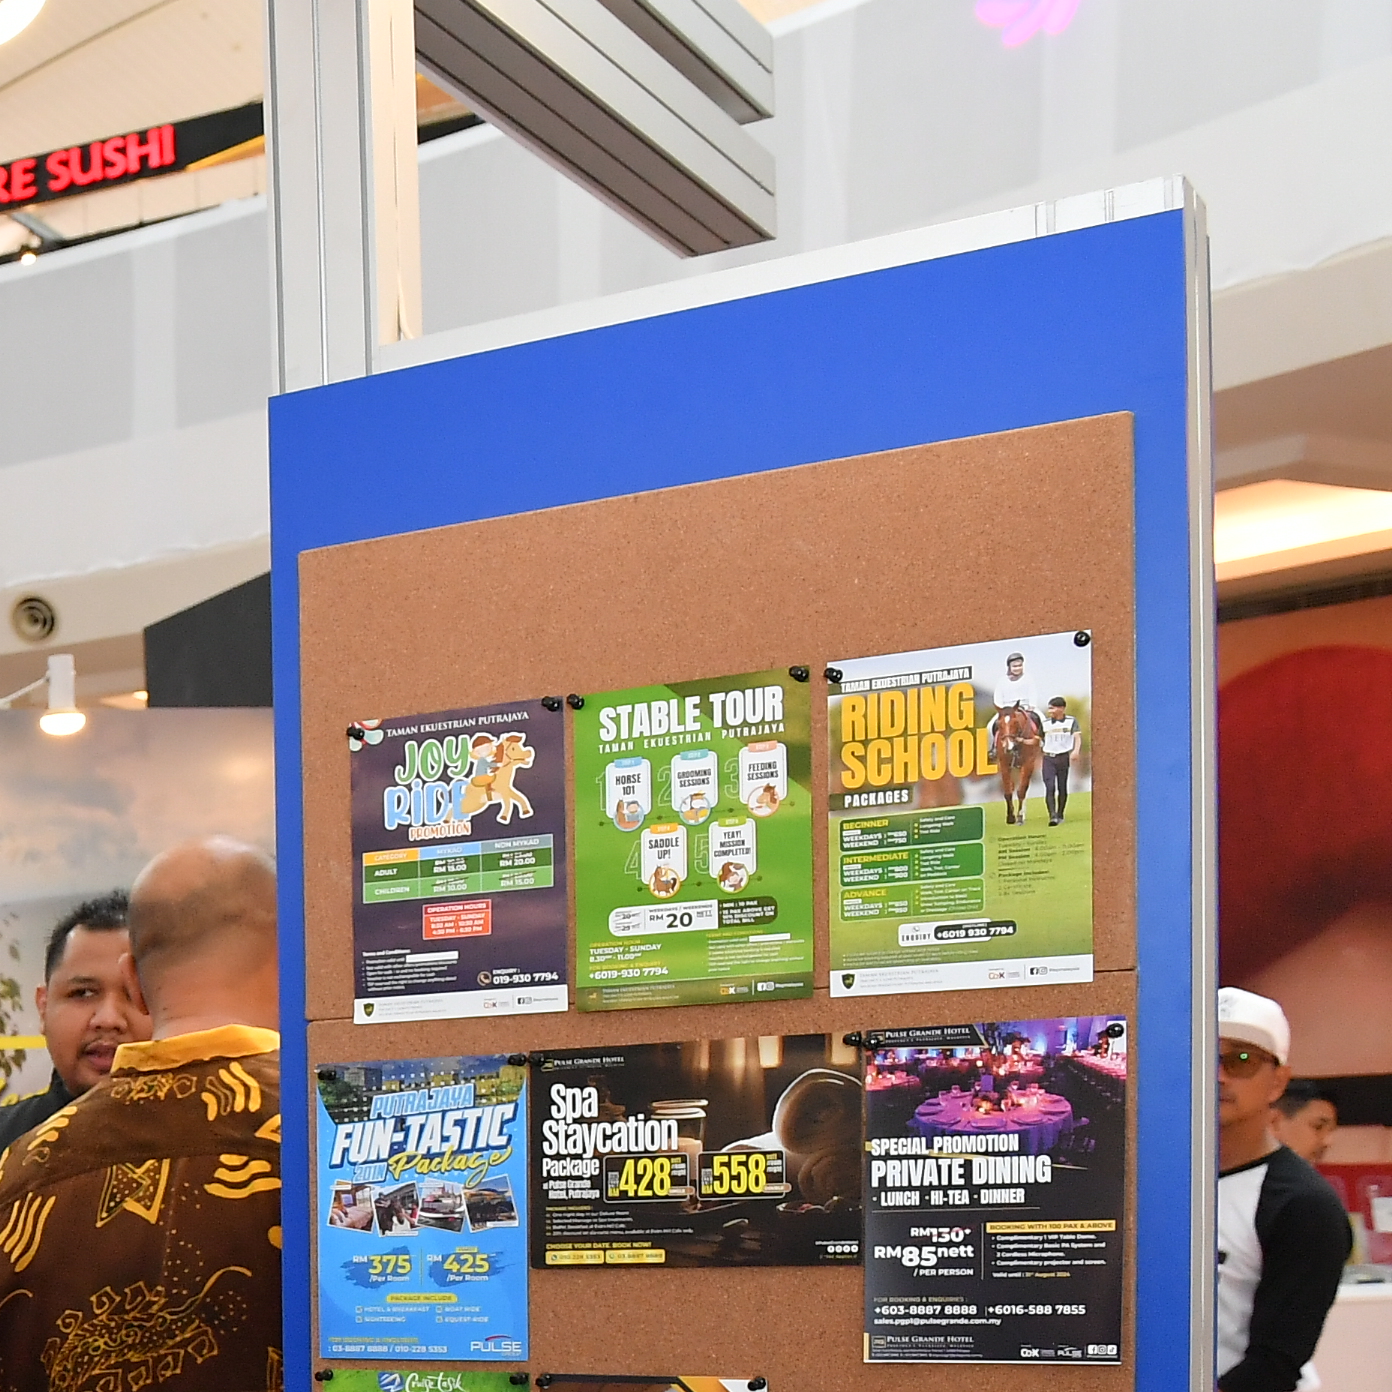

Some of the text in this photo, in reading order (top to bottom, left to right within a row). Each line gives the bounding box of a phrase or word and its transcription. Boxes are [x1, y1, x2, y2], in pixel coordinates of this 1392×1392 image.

[46, 125, 176, 191] SUSHI
[599, 685, 783, 742] STABLE TOUR
[841, 683, 975, 742] RIDING
[386, 711, 529, 737] TAMAN PUTRAJAYA
[599, 723, 785, 754] TAMAN EKUESTRIAN PUTRAJAYA
[841, 727, 999, 789] SCHOOL
[616, 774, 641, 785] HORSE
[844, 789, 909, 808] PACKAGES
[843, 819, 889, 830] BEGINNER
[648, 837, 680, 849] SADDLE
[723, 831, 742, 840] YEAY!
[514, 857, 535, 865] 20.00
[843, 852, 909, 863] INTERMEDIATE
[374, 868, 398, 876] ADULT
[375, 887, 410, 895] CHILDREN
[844, 889, 887, 898] ADVANCE
[666, 912, 693, 929] 20
[937, 928, 987, 939] +6019 930
[630, 944, 662, 952] SUNDAY
[493, 974, 531, 985] 019-930
[550, 1084, 598, 1124] Spa
[330, 1103, 517, 1166] FUN-TASTIC
[542, 1114, 678, 1159] Staycation
[871, 1134, 1019, 1156] SPECIAL PROMOTION
[388, 1144, 512, 1188] Package
[542, 1157, 600, 1179] Package
[713, 1154, 767, 1195] 558
[871, 1155, 1052, 1188] PRIVATE DINING
[619, 1157, 671, 1198] 428
[930, 1189, 1025, 1206] HI-TEA DINNER
[368, 1254, 411, 1274] 375
[443, 1253, 490, 1274] 425
[874, 1305, 941, 1316] +603-8887
[470, 1341, 522, 1352] PULSE
